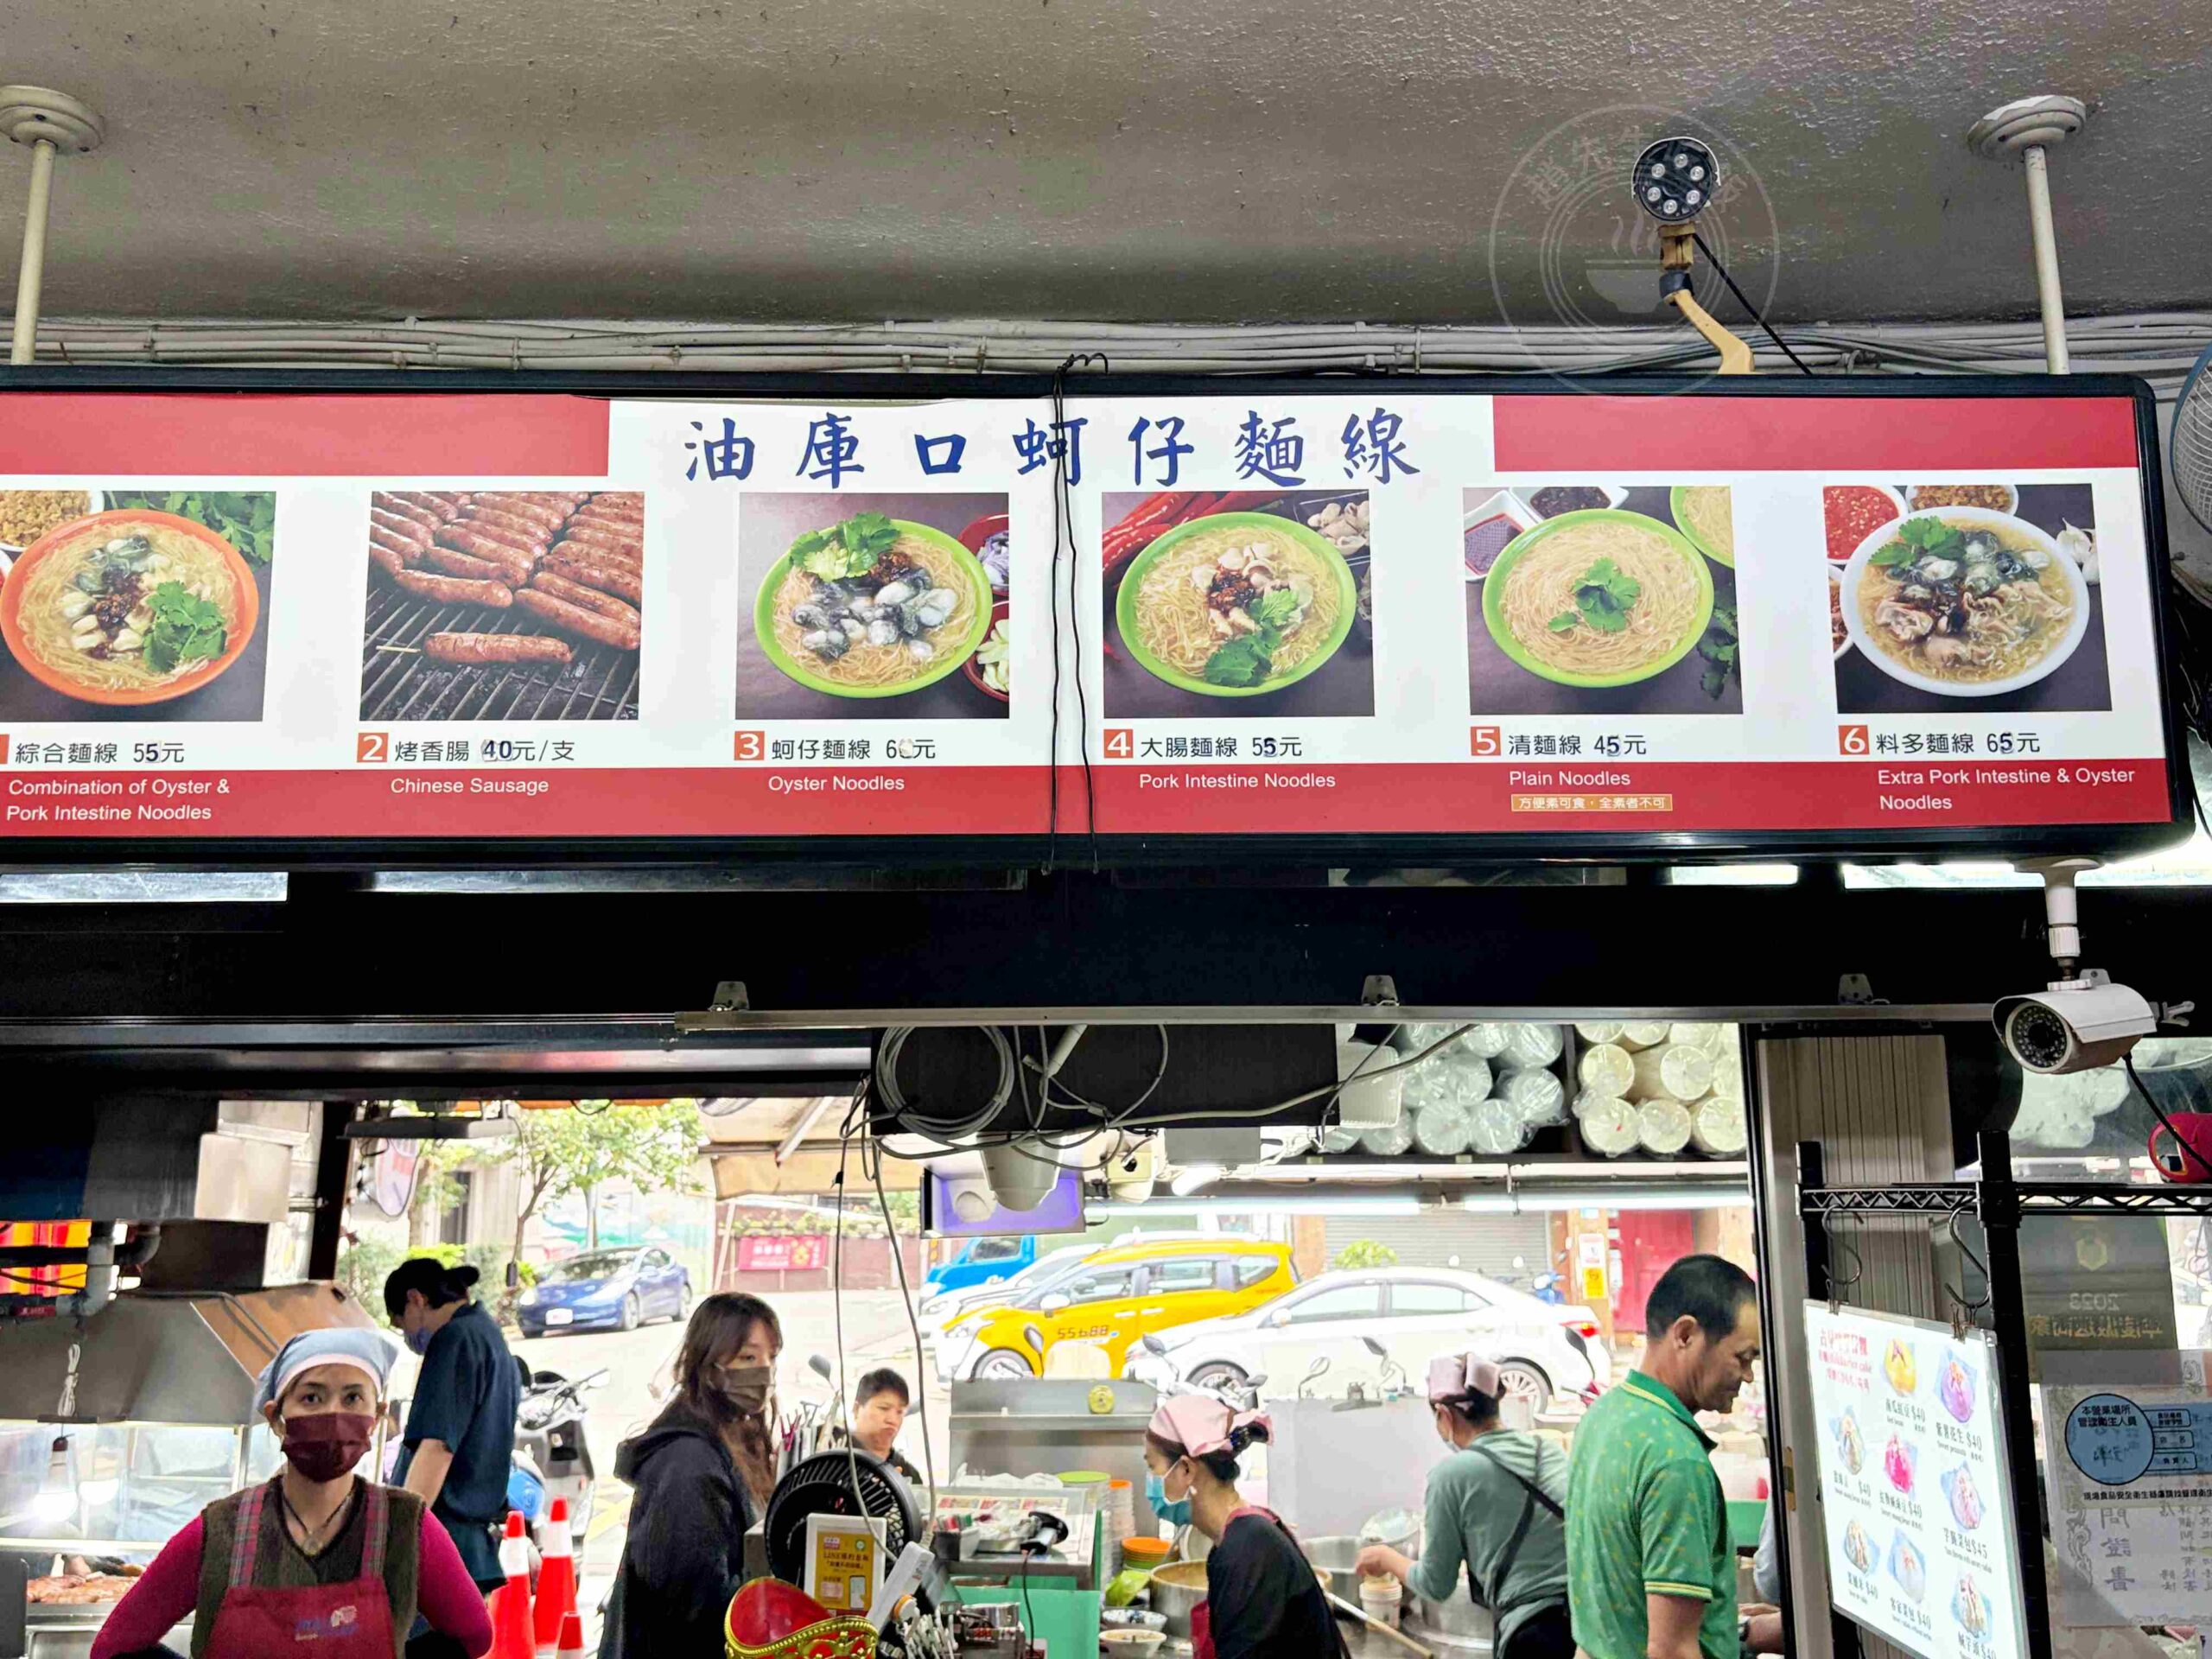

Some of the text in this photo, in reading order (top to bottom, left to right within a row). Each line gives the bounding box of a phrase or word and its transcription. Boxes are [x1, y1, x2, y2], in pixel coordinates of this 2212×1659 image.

[683, 408, 1421, 487] 油庫口蚵仔麵線
[362, 735, 384, 761] 2
[394, 739, 575, 762] 烤香腸 40元/支
[739, 734, 760, 759] 3
[772, 739, 871, 760] 蚵仔麵線
[1107, 732, 1130, 756] 4
[1141, 736, 1302, 758] 大腸麵線 55元
[1476, 728, 1497, 754] 5
[1509, 734, 1646, 756] 清麵線 45元
[1843, 728, 1866, 753] 6
[1876, 732, 2040, 754] 料多麵線 65元
[15, 742, 185, 764] 綜合麵線 55元
[390, 778, 549, 796] Chinese Sausage
[767, 776, 905, 794] Oyster Noodles
[1139, 773, 1336, 788] Pork Intestine Noodles
[1509, 771, 1630, 785] Plain Noodles
[1878, 767, 2135, 786] Extra Pork Intestine & Oyster
[9, 778, 231, 798] Combination of Oyster &
[7, 804, 212, 821] Pork Intestine Noodles
[1879, 795, 1953, 810] Noodles
